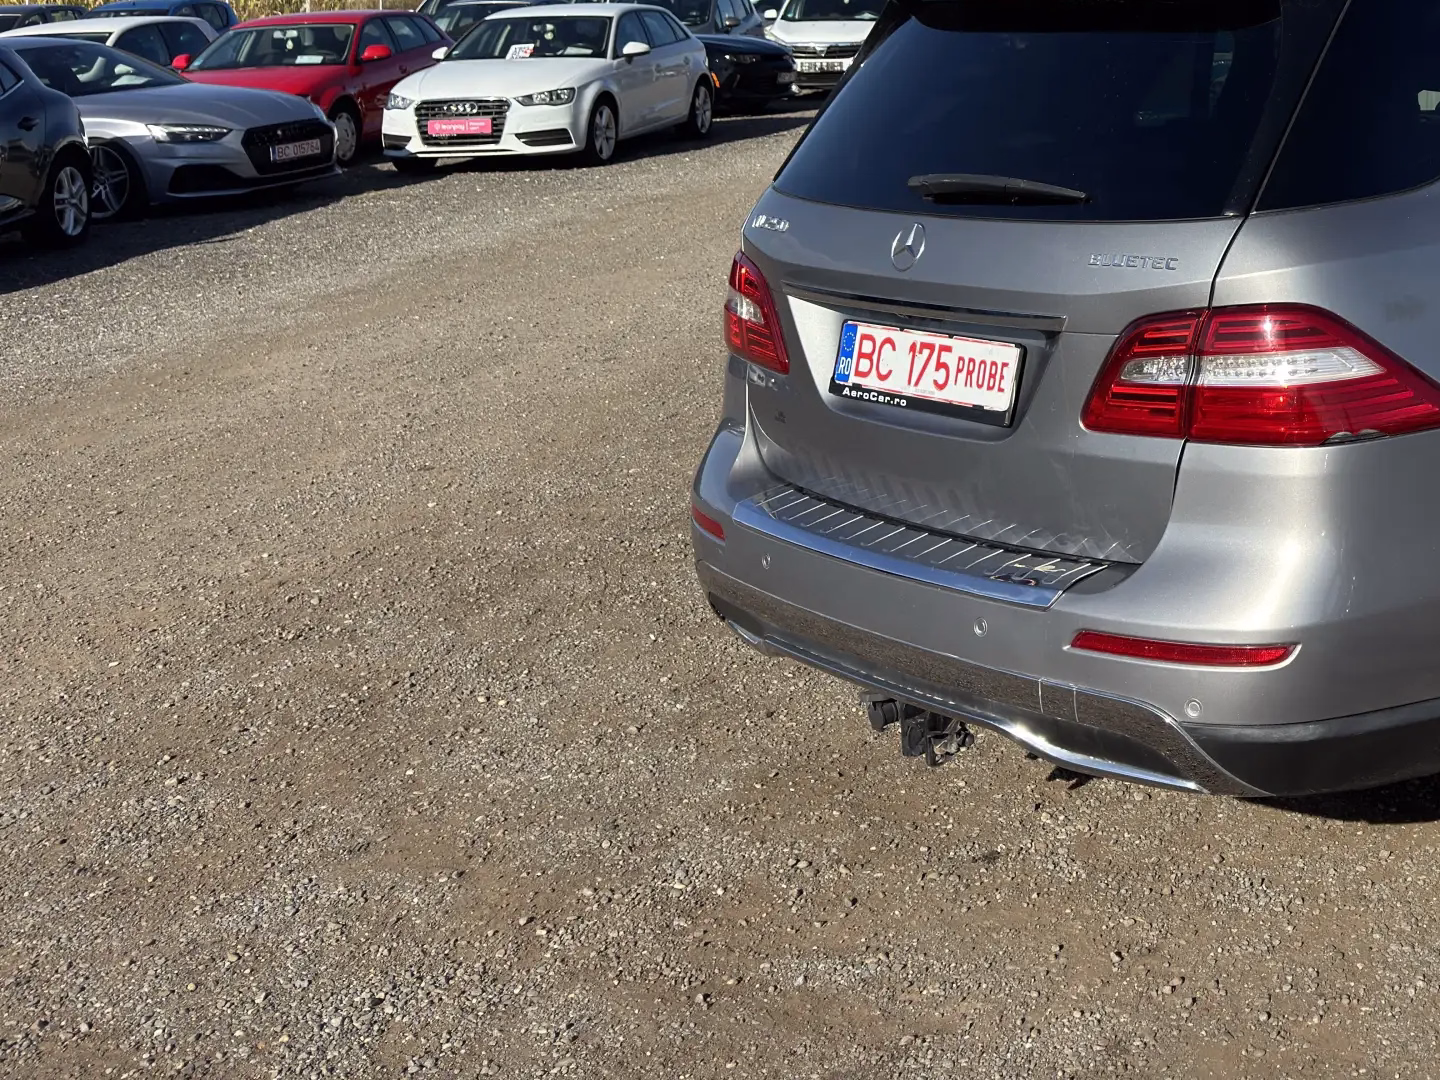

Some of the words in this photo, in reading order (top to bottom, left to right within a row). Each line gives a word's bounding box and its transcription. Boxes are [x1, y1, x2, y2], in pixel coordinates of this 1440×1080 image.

[1088, 253, 1179, 271] BLUETEC
[839, 356, 852, 376] RO
[853, 333, 897, 382] BC
[907, 340, 953, 392] 175
[954, 355, 1010, 393] PROBE
[842, 386, 907, 407] AeroCar.ro
